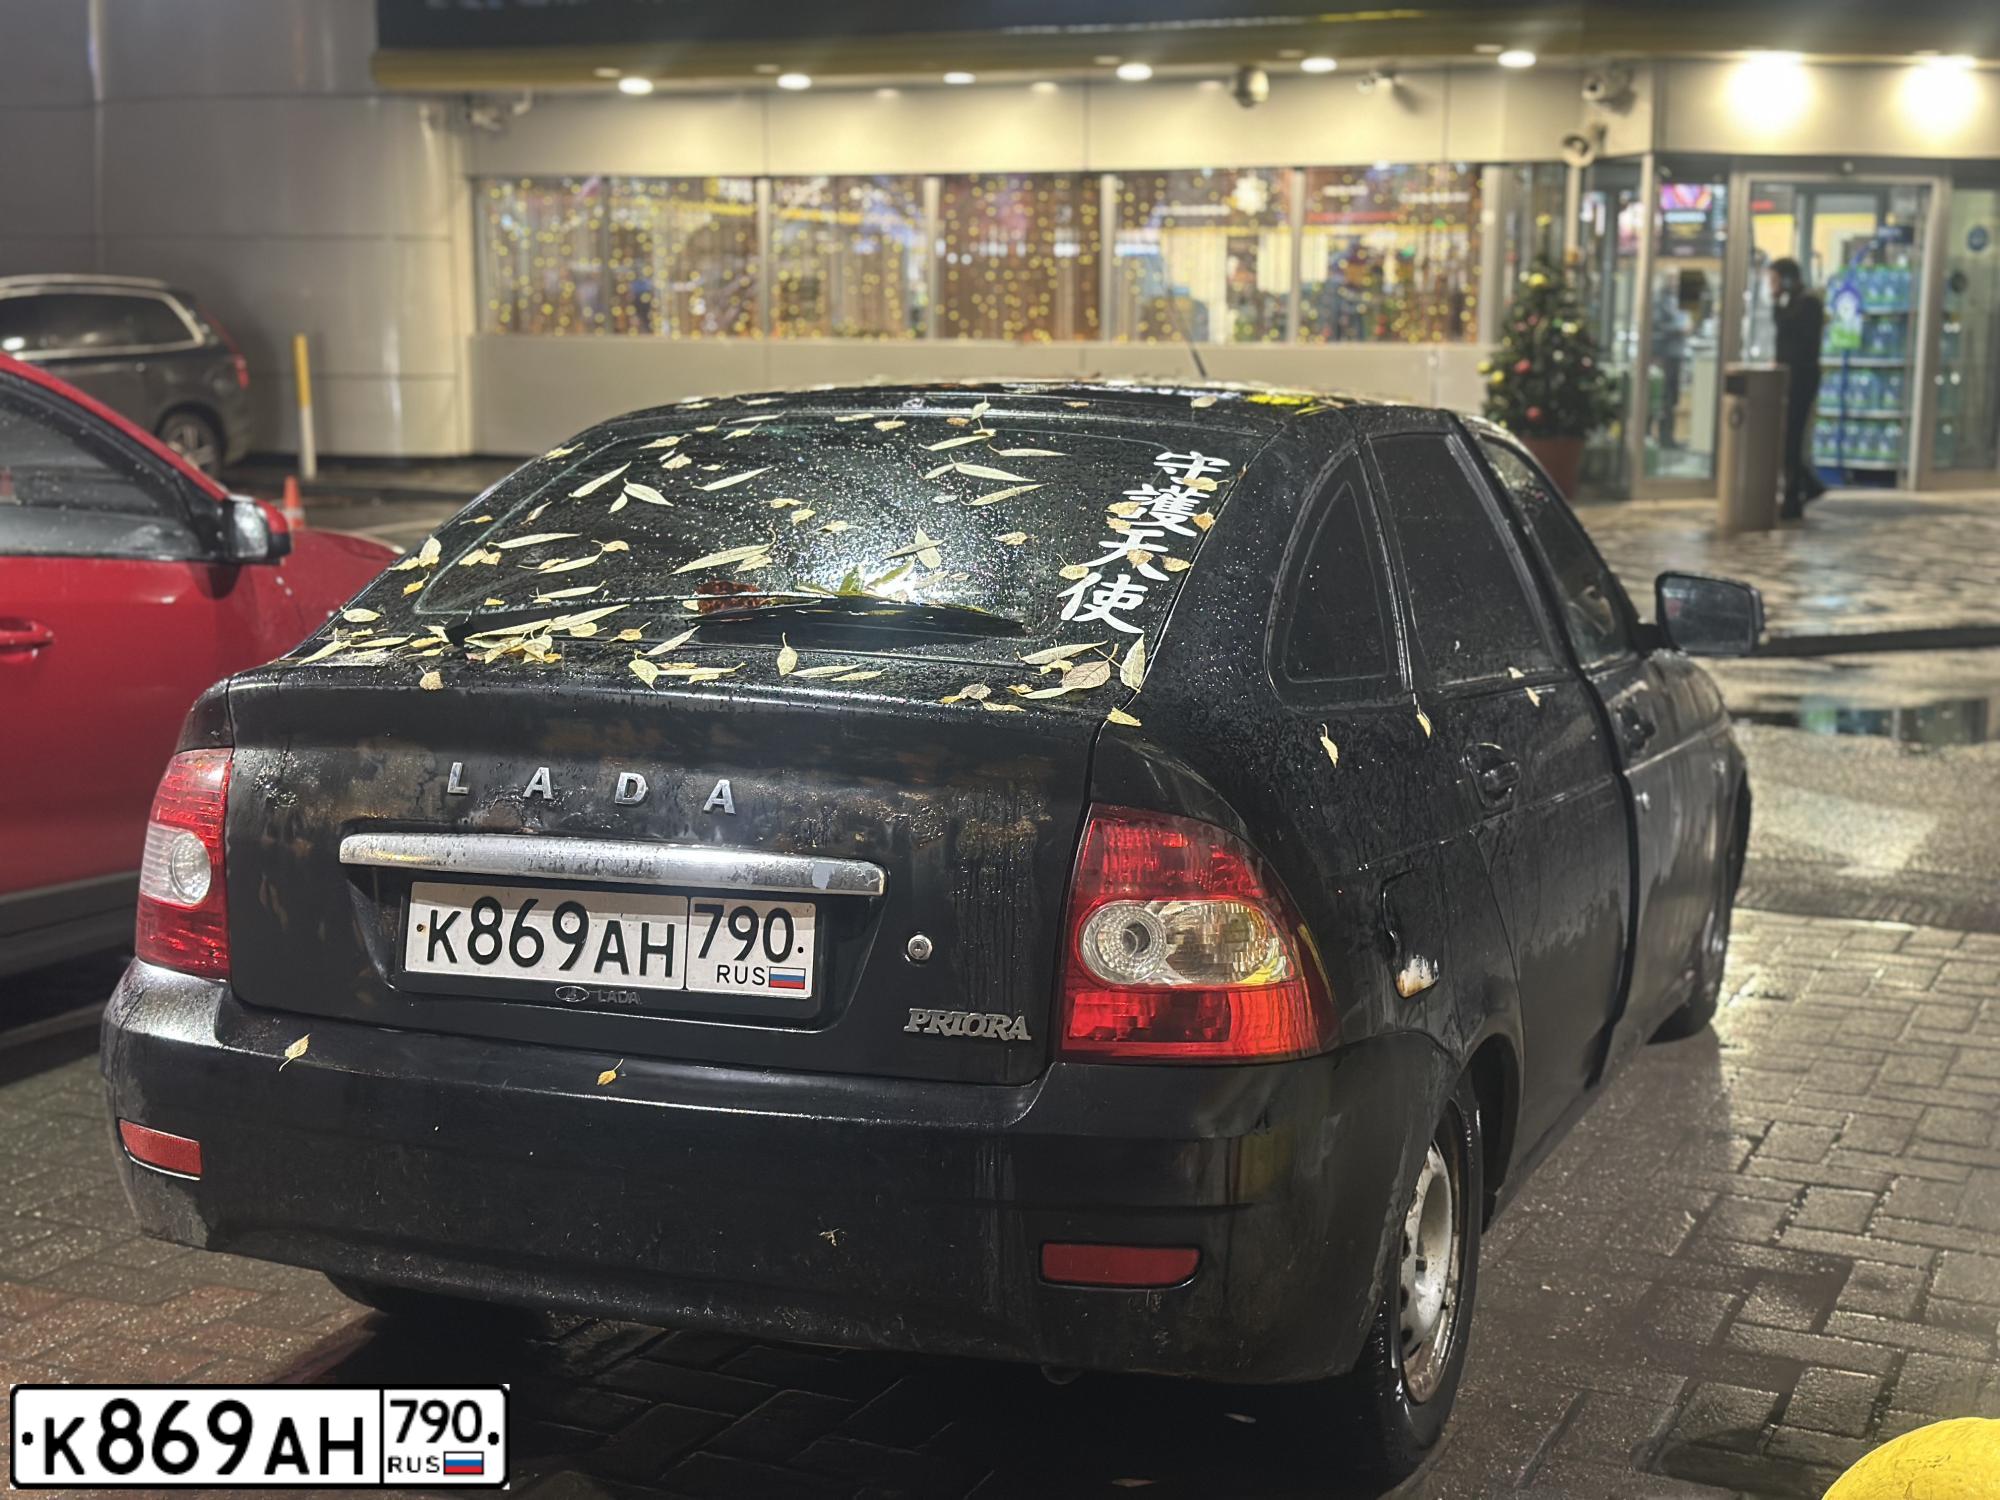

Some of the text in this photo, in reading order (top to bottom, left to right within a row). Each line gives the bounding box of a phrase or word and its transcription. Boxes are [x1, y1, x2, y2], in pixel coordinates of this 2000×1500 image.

[447, 762, 737, 815] LADA
[427, 896, 794, 978] K869AH 790
[716, 964, 766, 986] RUS
[597, 989, 642, 1005] LADA
[903, 1007, 1032, 1041] PRIORA
